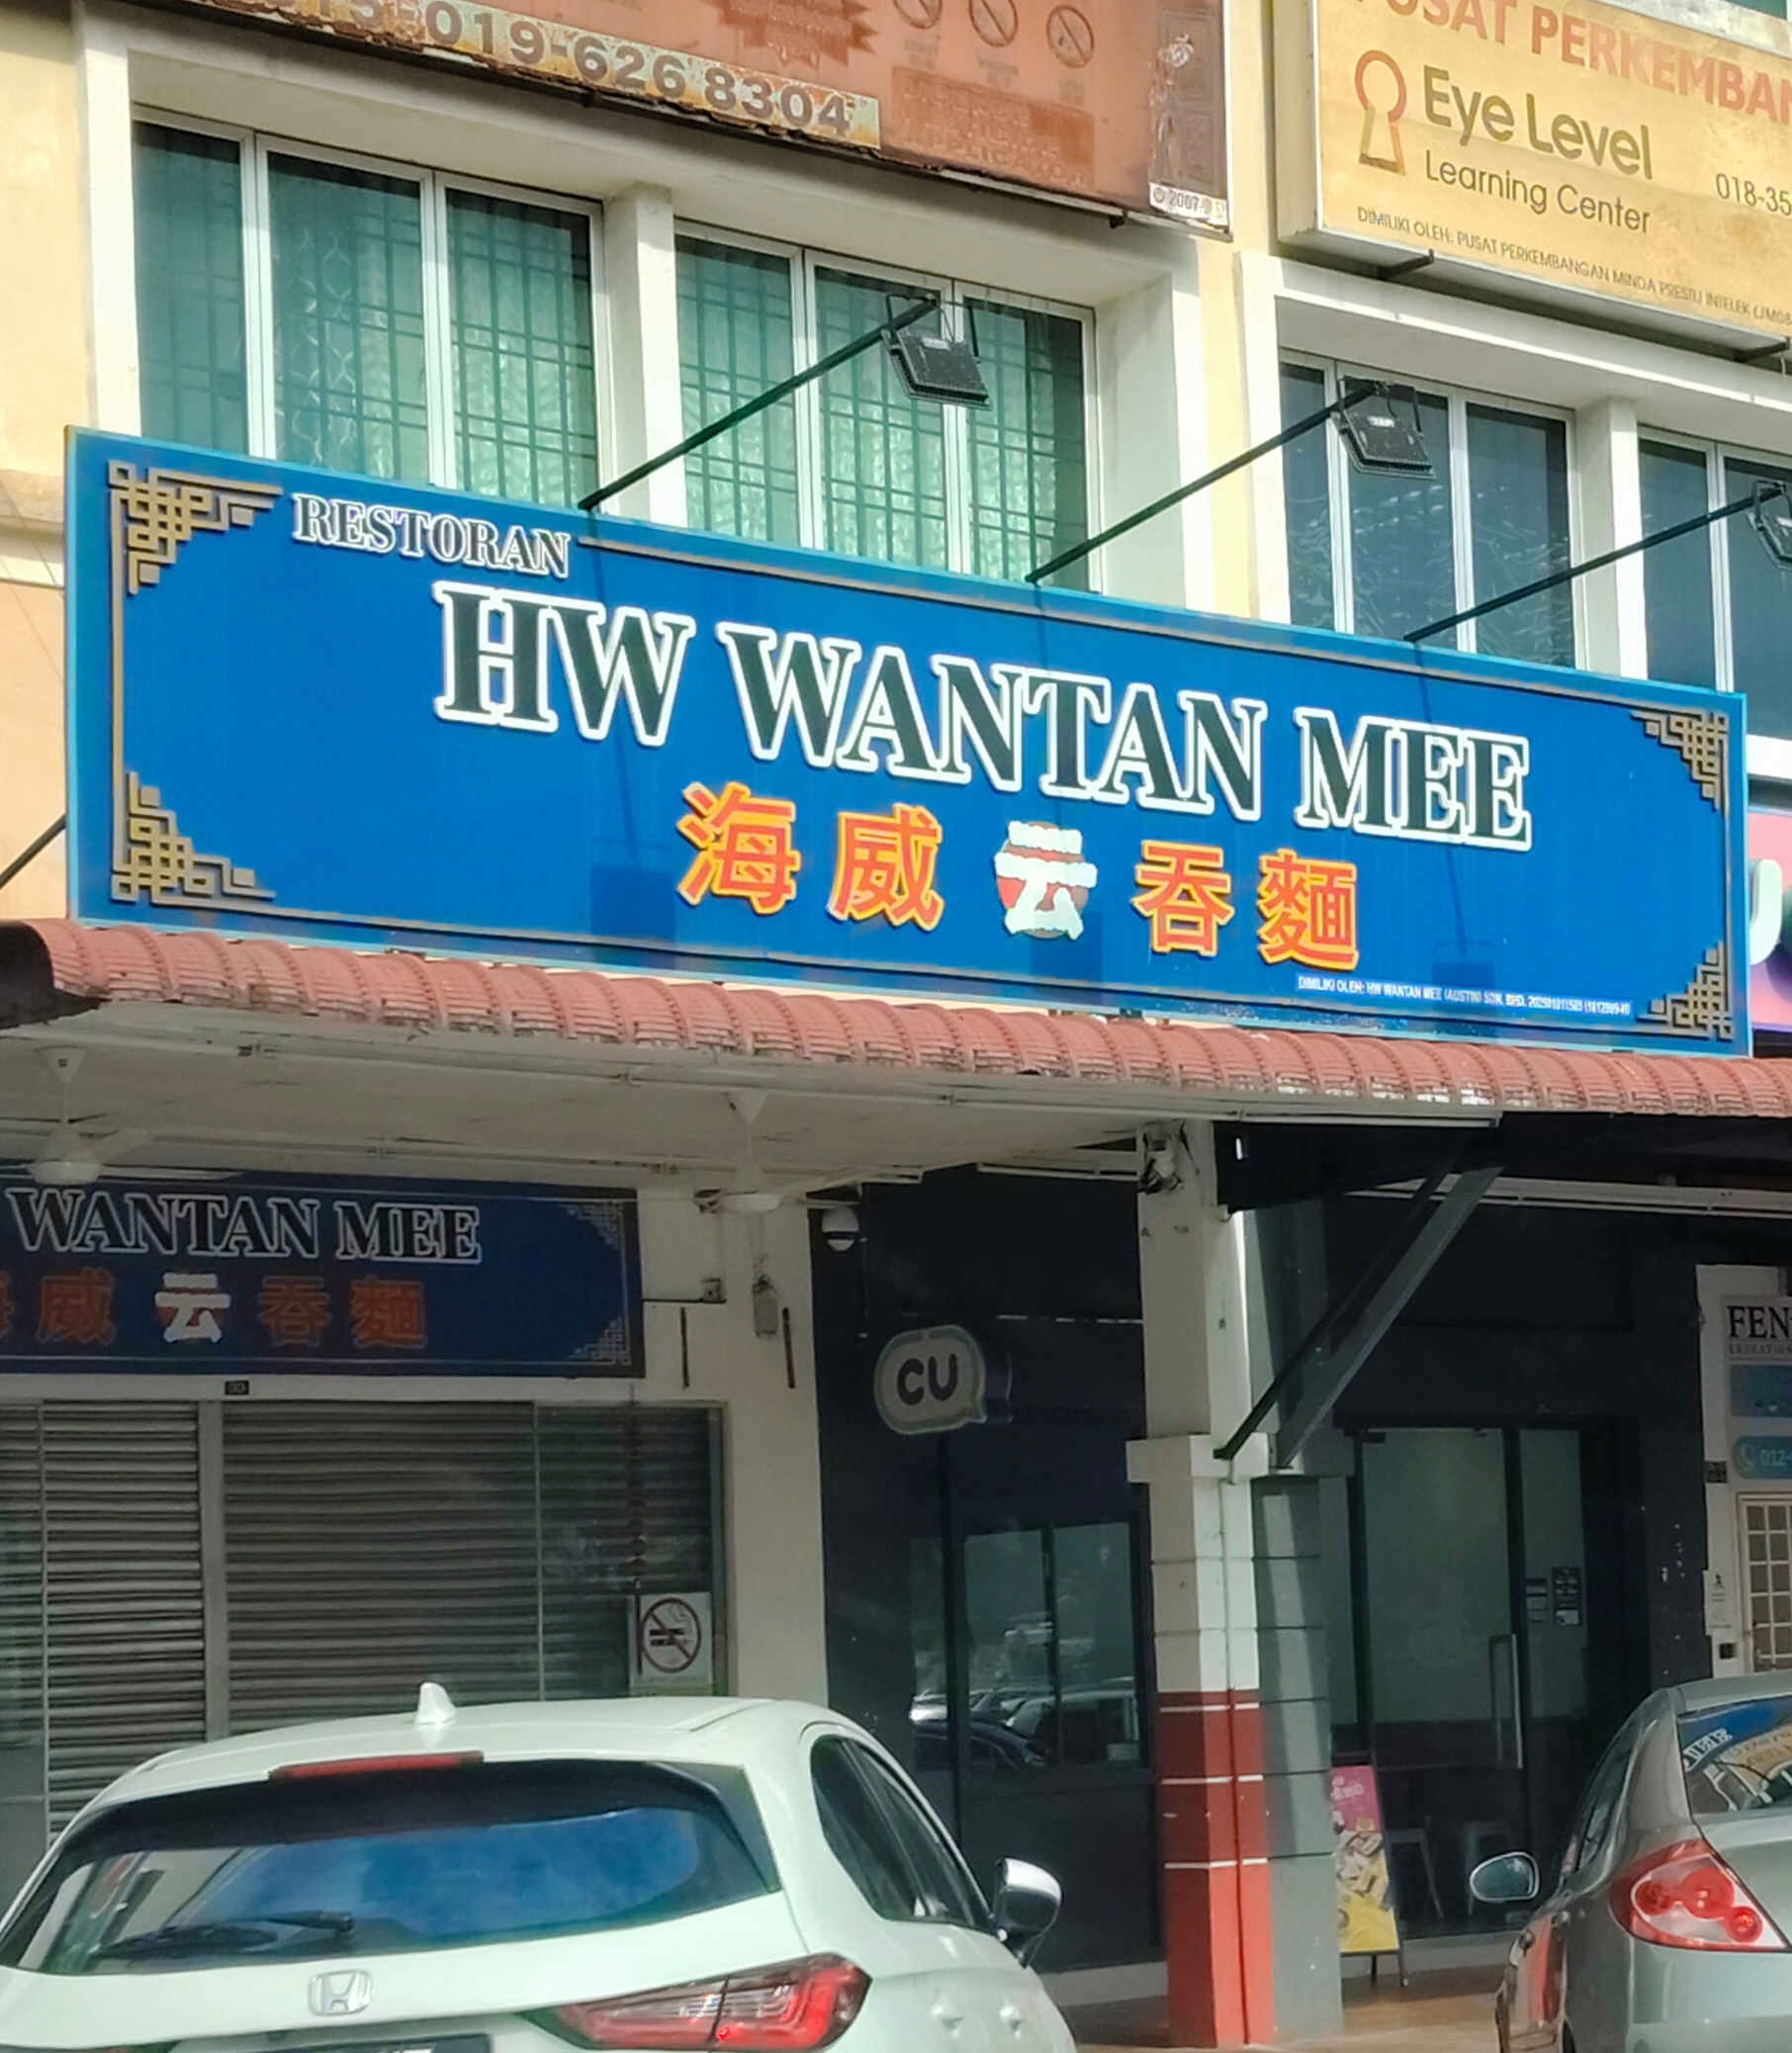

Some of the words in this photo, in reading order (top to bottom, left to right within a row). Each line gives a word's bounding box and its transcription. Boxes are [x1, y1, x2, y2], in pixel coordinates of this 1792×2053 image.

[1357, 0, 1518, 45] SAT
[703, 65, 851, 136] 8304
[1423, 63, 1515, 147] Eye
[1526, 92, 1653, 180] Level
[1425, 149, 1548, 215] Learning
[1557, 184, 1651, 233] Center
[1357, 206, 1410, 233] DIMILIKI
[1413, 221, 1453, 243] OLEH:
[1457, 230, 1498, 255] PUSAT
[1501, 241, 1610, 283] PERKEMBANGAN
[1612, 268, 1658, 294] MINDA
[1706, 292, 1750, 318] INTELEK
[291, 491, 572, 579] RESTORAN
[432, 580, 696, 748] HW
[716, 620, 1268, 821] WANTAN
[1293, 706, 1533, 851] MEE
[1298, 975, 1335, 992] DIMILIKI
[1367, 981, 1383, 996] HW
[1384, 983, 1422, 999] WANTAN
[1423, 986, 1443, 1001] MEE
[4, 1189, 319, 1260] WANTAN
[335, 1199, 484, 1265] MEE
[0, 1267, 428, 1349] 威云吞麵
[1726, 1305, 1792, 1338] FEN
[897, 1352, 958, 1406] CU
